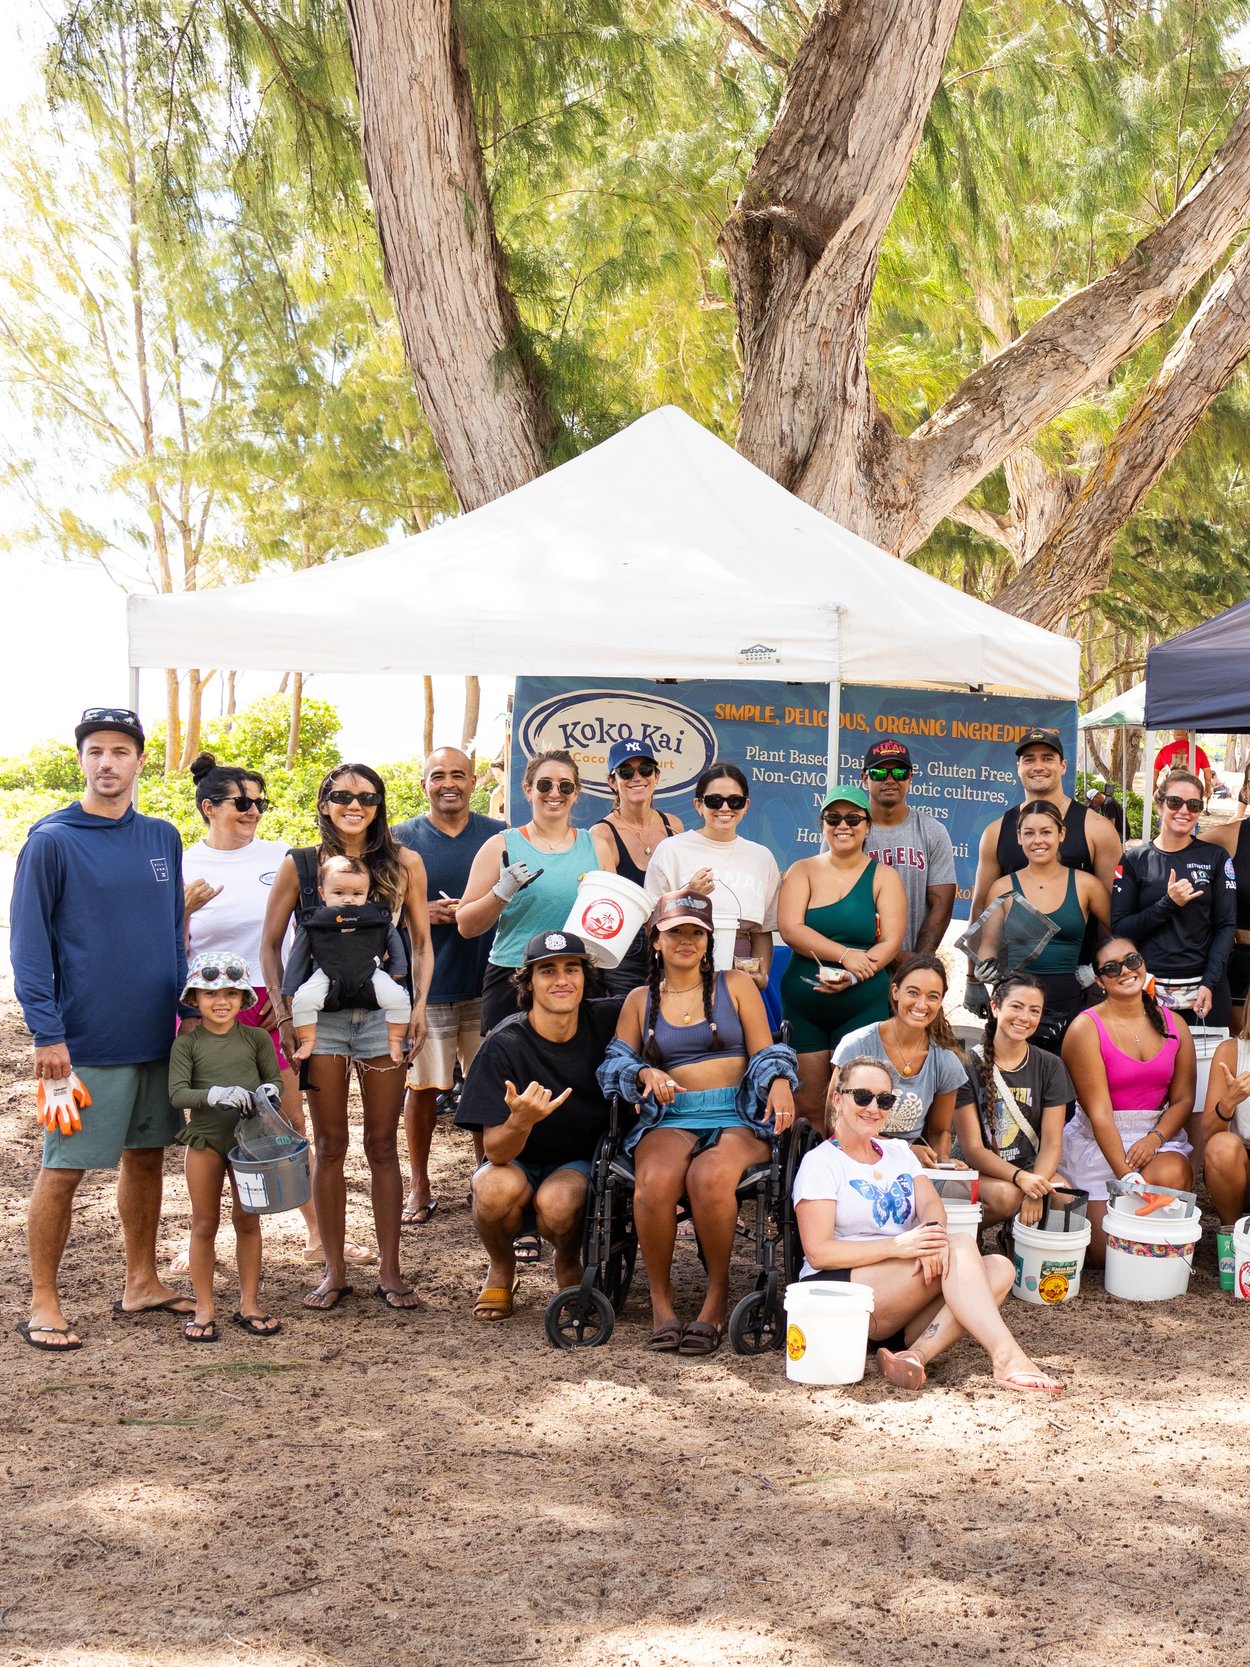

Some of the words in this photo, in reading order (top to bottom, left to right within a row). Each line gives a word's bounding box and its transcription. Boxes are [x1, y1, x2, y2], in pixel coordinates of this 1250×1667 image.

[714, 703, 780, 726] SIMPLE,
[785, 707, 870, 734] DELICOUS,
[874, 714, 947, 737] ORGANIC
[558, 717, 633, 749] Koko
[641, 723, 685, 754] Kai
[745, 746, 786, 763] Plant
[840, 754, 865, 770] Dai
[927, 761, 977, 780] Gluten
[980, 766, 1017, 785] Free,
[944, 784, 1009, 806] cultures,
[868, 846, 925, 871] NGELS
